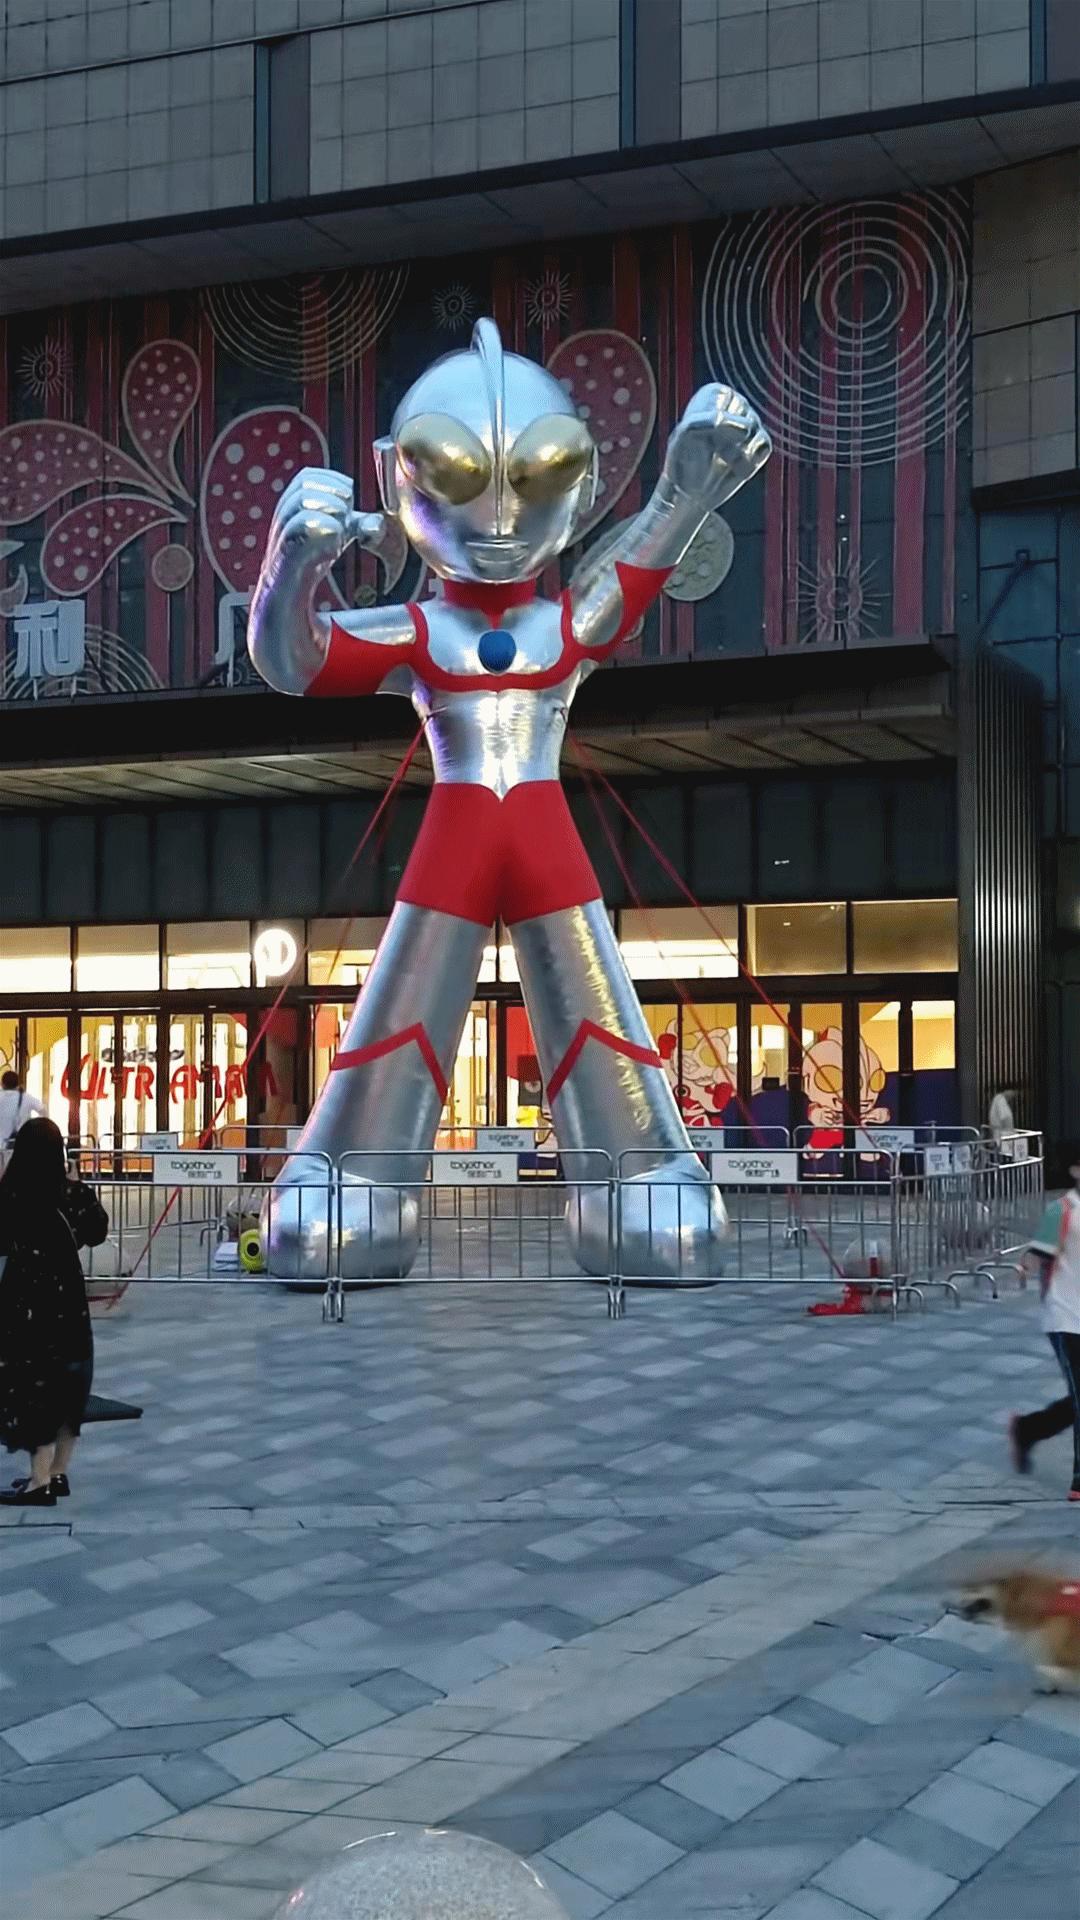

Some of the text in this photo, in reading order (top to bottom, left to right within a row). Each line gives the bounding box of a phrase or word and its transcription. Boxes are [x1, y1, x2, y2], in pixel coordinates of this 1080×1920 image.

[170, 1160, 216, 1172] together
[450, 1160, 496, 1172] together
[727, 1159, 773, 1171] together
